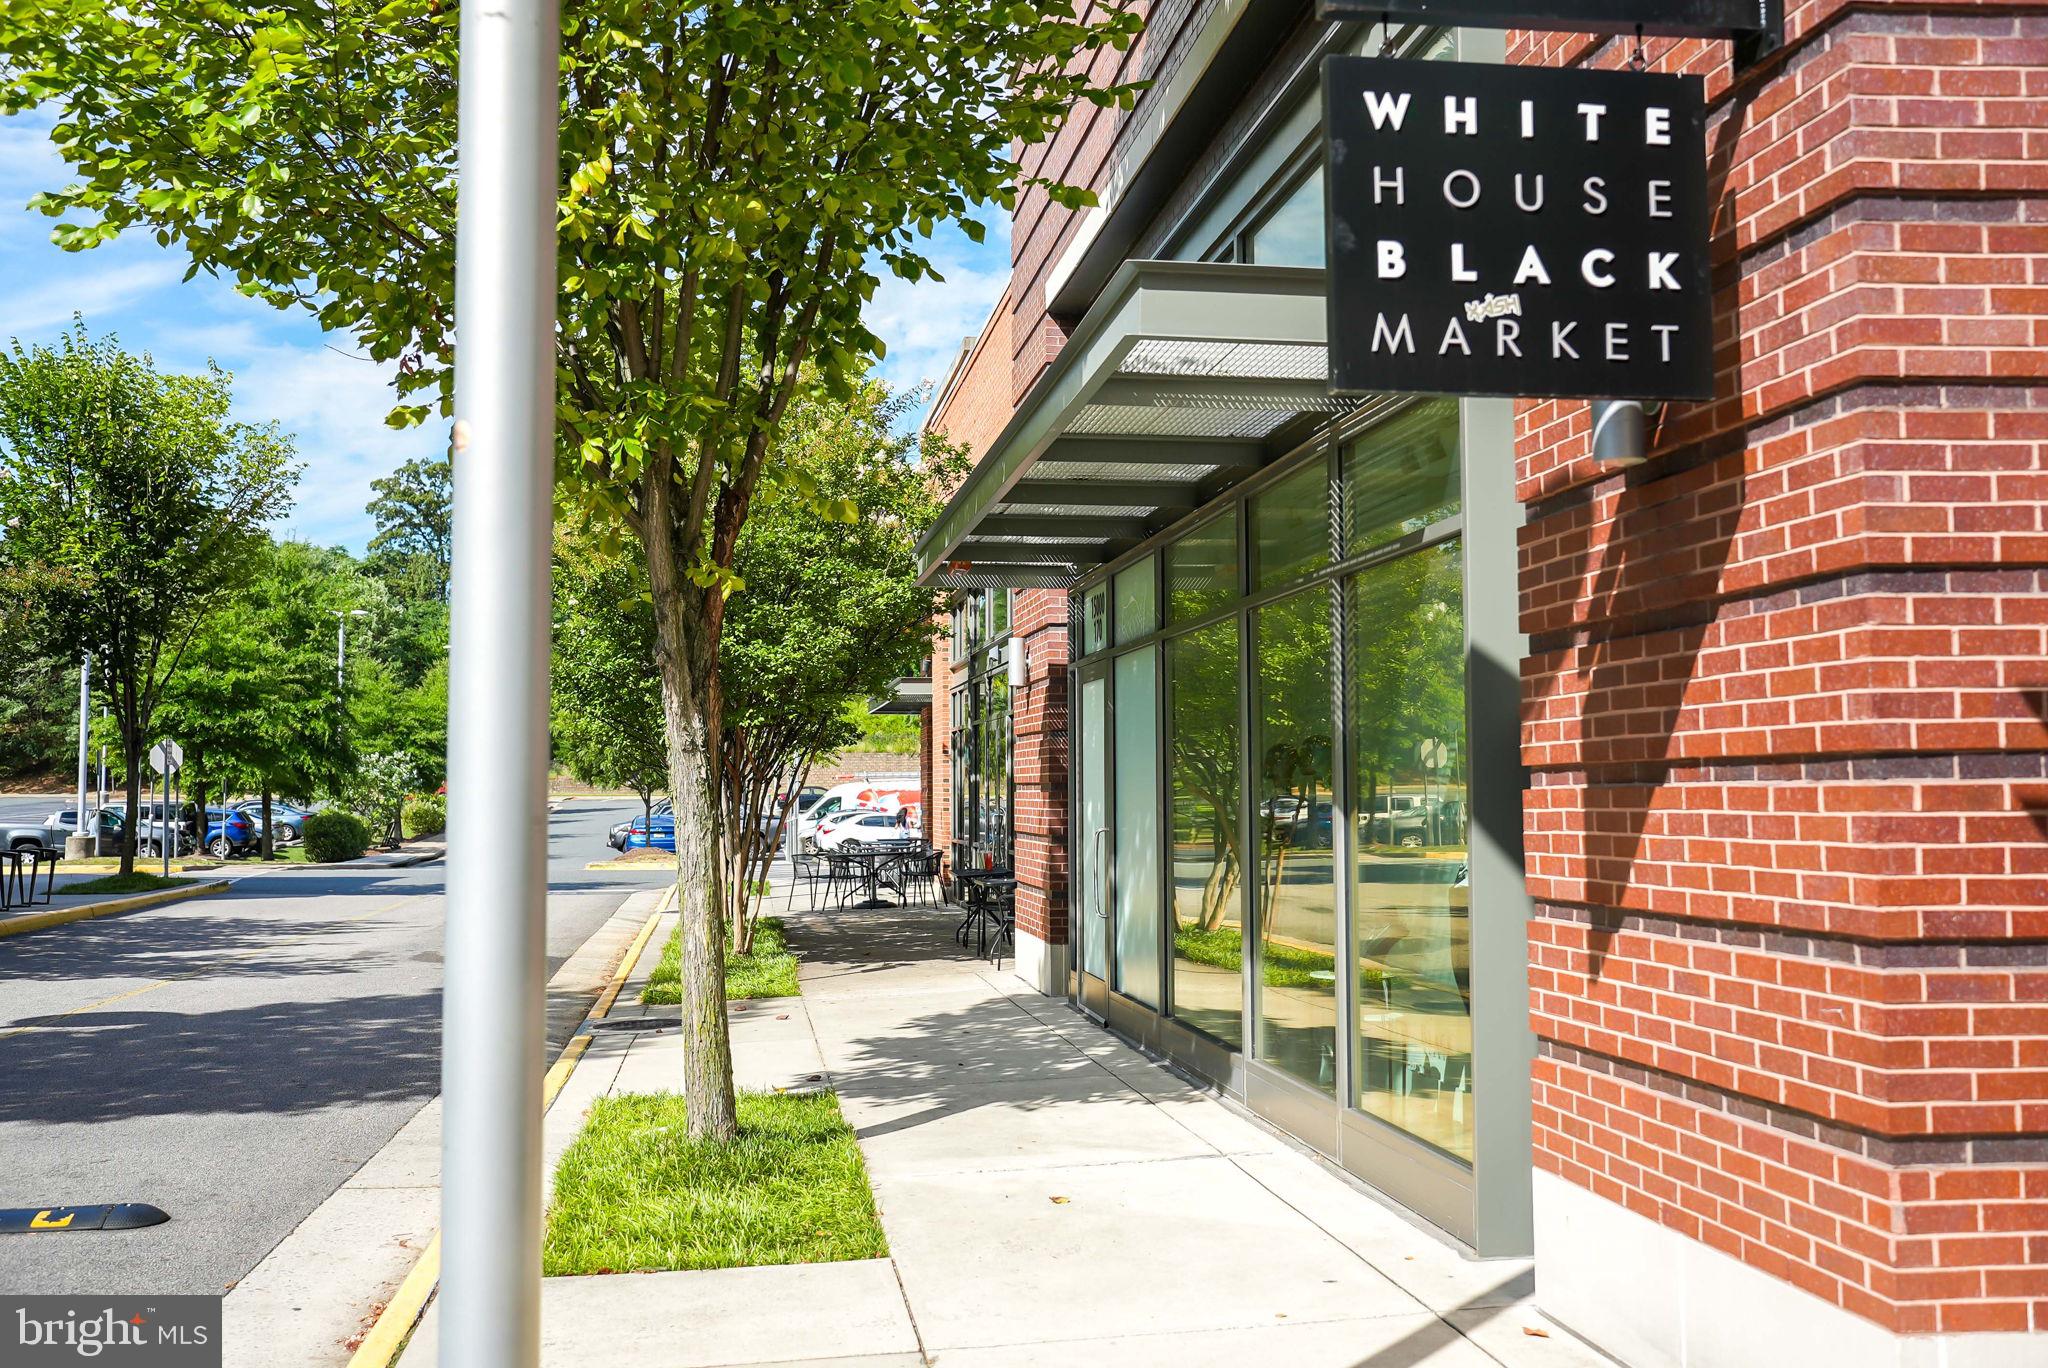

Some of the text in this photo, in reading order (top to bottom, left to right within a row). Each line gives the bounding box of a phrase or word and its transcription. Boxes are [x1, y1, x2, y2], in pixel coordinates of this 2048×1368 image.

[1363, 91, 1672, 145] WHITE
[1373, 166, 1673, 218] HOUSE
[1377, 240, 1683, 290] BLACK
[1371, 312, 1680, 362] MARKET
